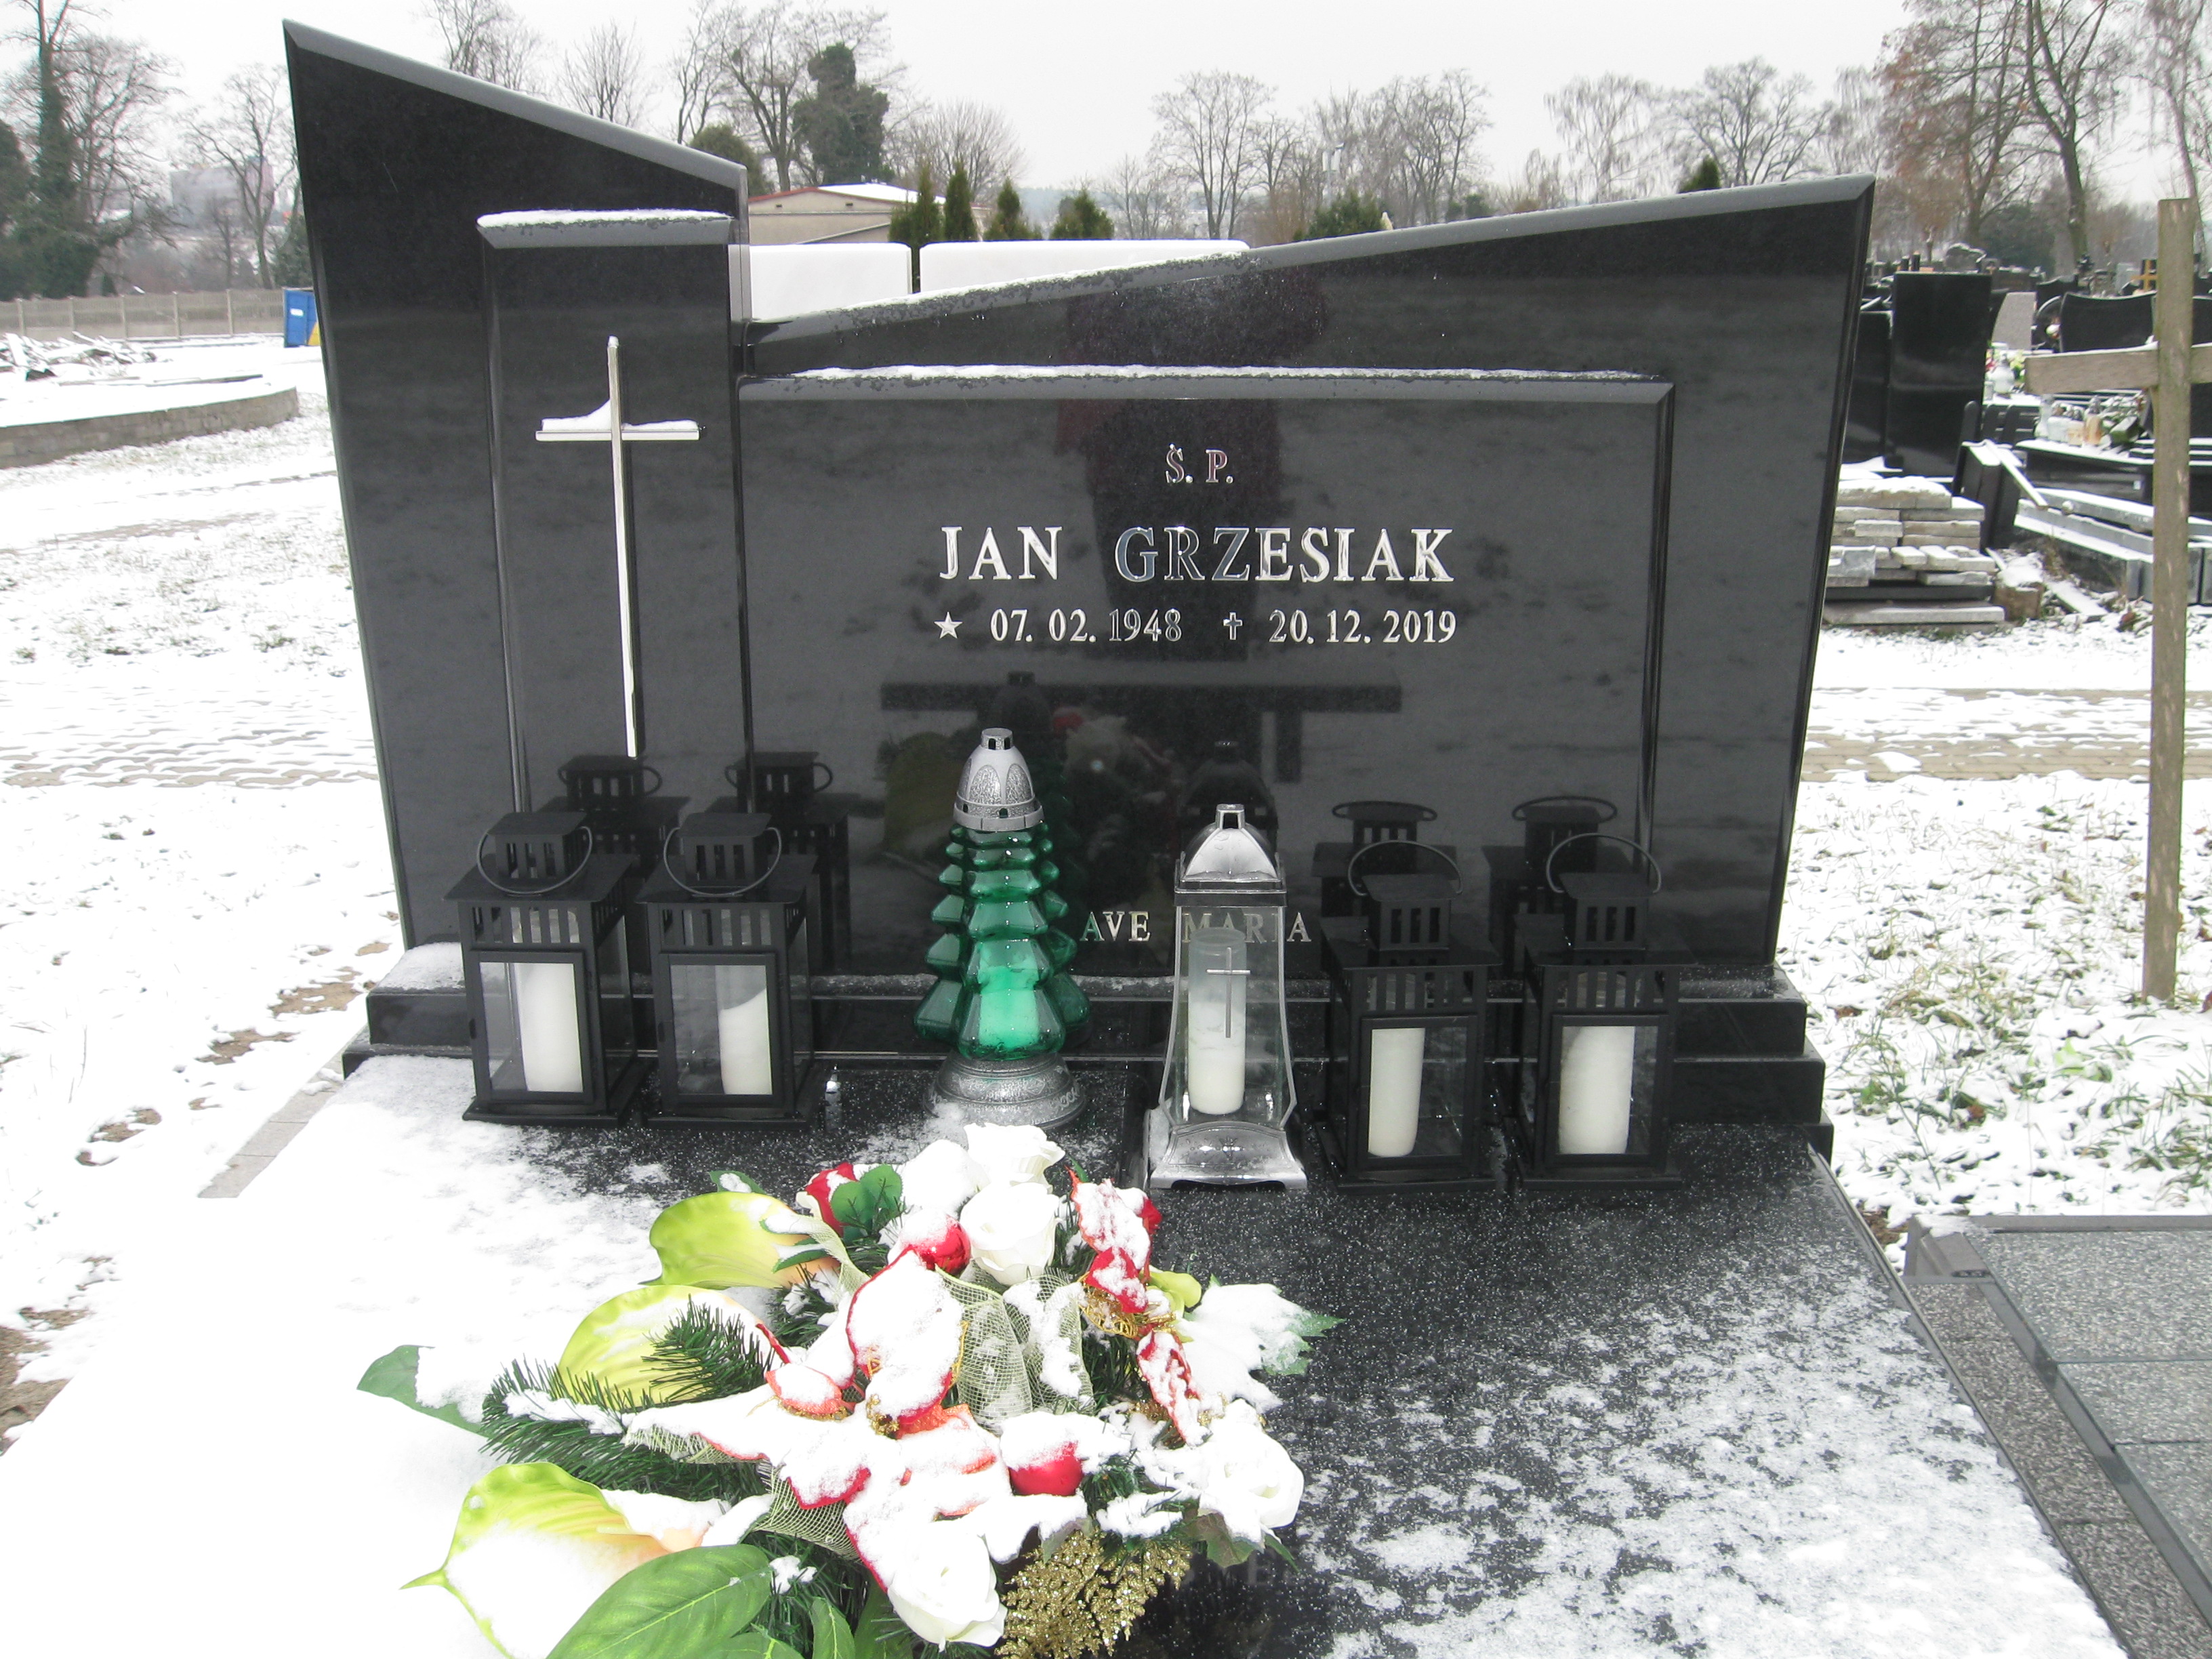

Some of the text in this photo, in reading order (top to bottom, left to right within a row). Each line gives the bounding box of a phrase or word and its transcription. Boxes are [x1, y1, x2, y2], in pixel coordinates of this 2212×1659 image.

[1206, 449, 1233, 484] P.
[939, 526, 1454, 583] JAN GRZESIAK
[990, 609, 1456, 644] 07. 02. 1948 20. 12. 2019
[1080, 911, 1151, 941] AVE
